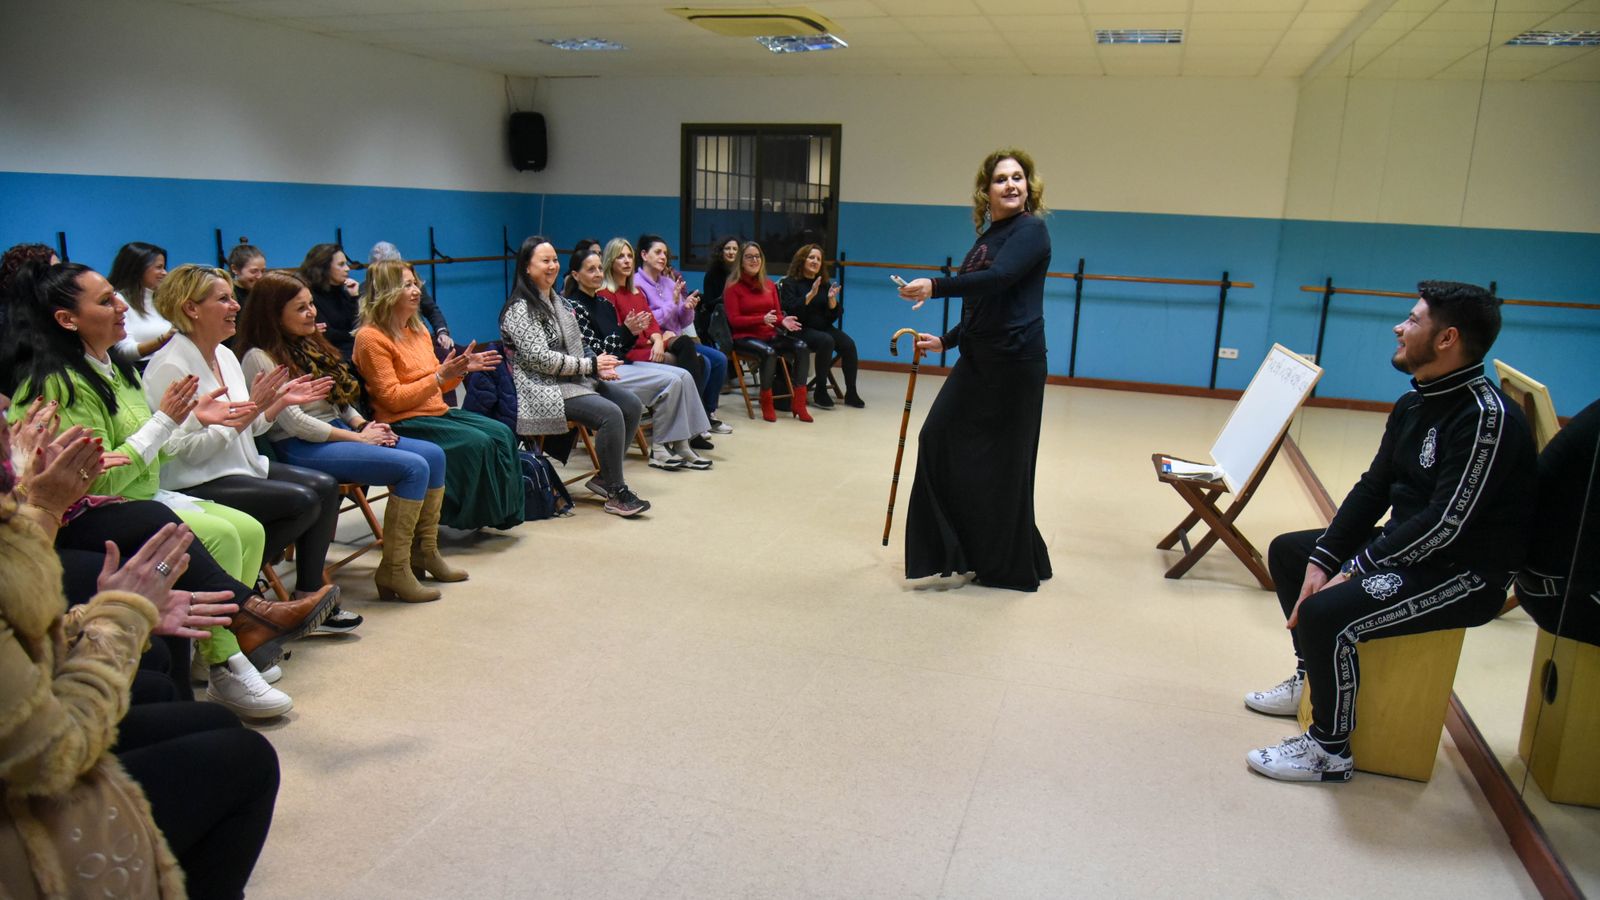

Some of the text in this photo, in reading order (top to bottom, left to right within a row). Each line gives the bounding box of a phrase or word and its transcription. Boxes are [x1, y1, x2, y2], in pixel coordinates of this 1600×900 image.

[1455, 487, 1474, 511] DOLCE
[1468, 448, 1489, 484] GABBANA
[1354, 620, 1375, 632] DOLCE
[1377, 607, 1408, 624] GABBANA
